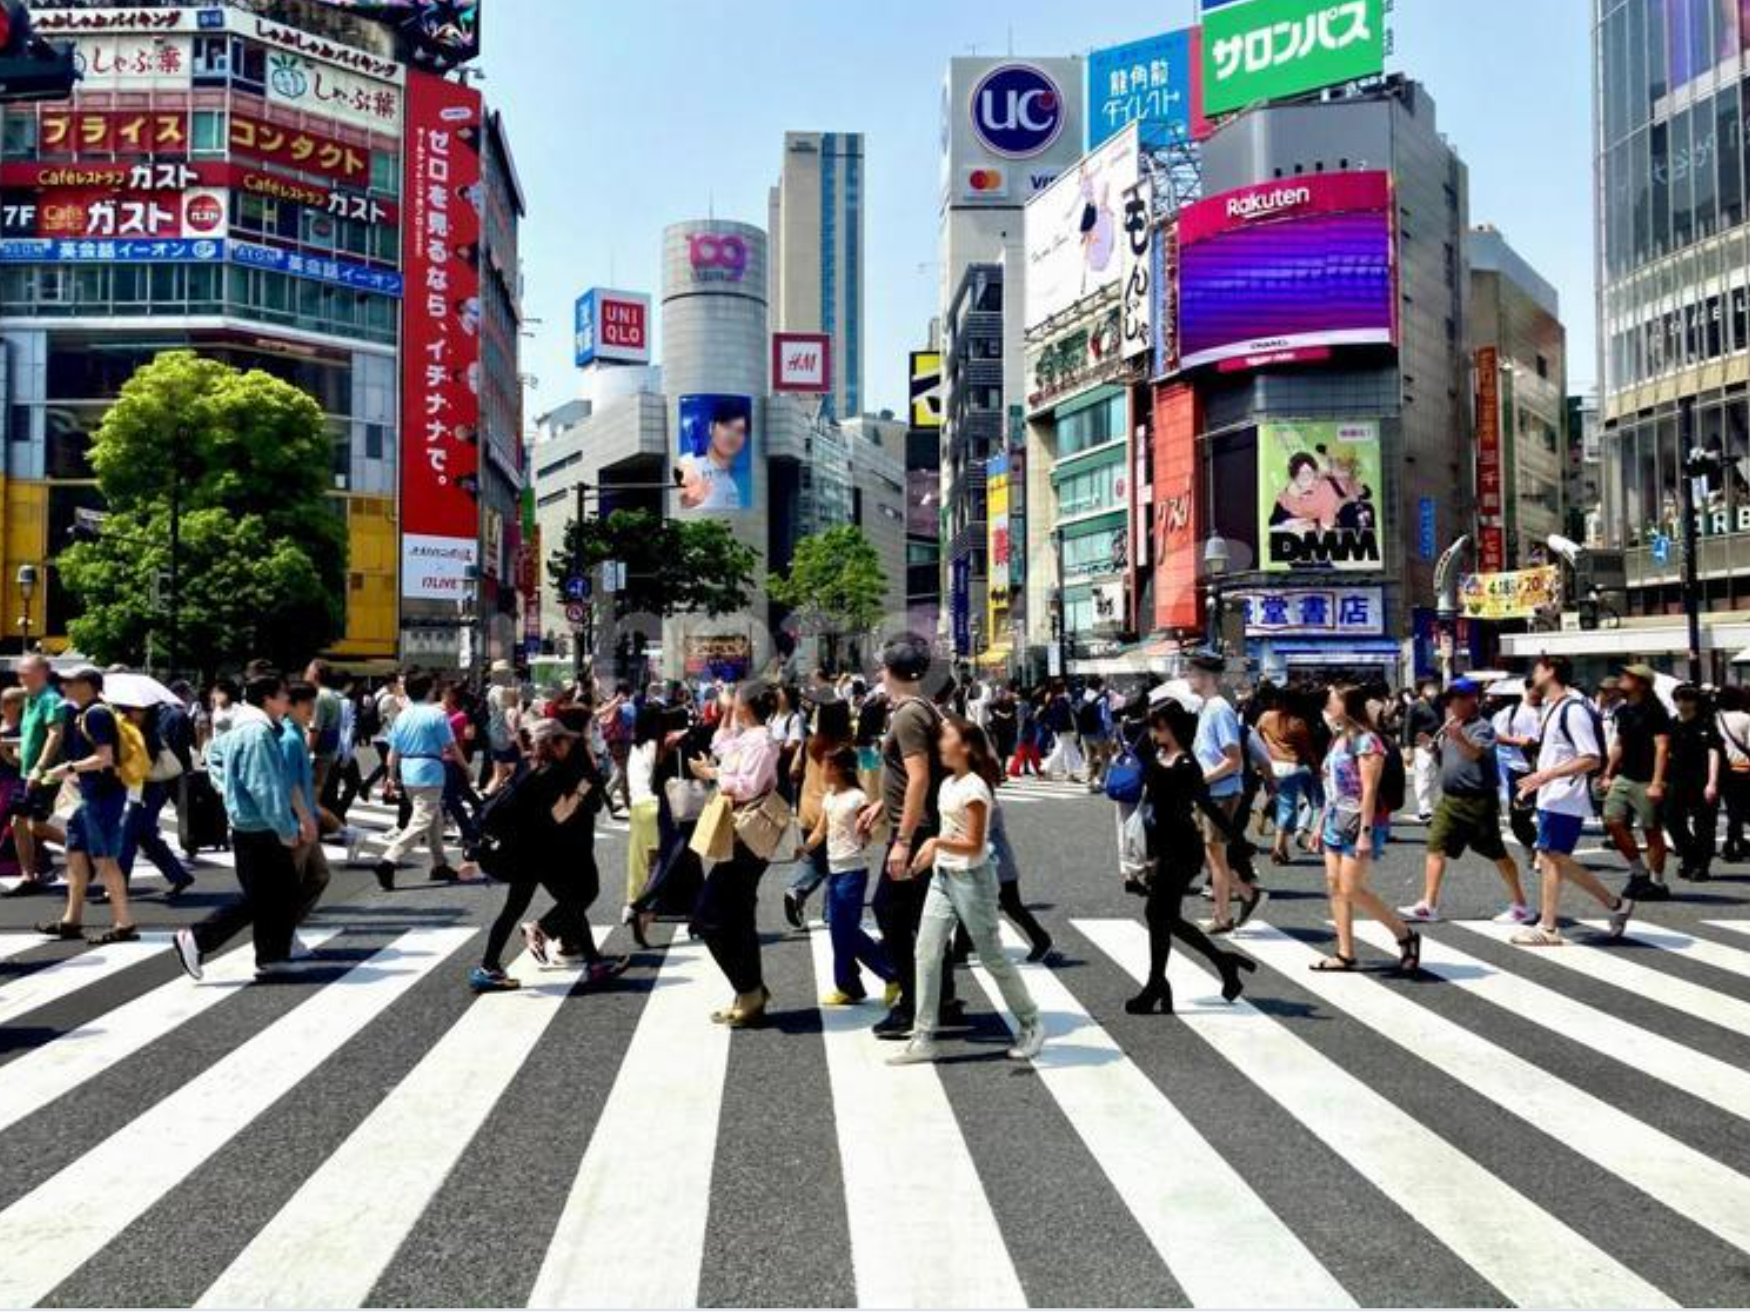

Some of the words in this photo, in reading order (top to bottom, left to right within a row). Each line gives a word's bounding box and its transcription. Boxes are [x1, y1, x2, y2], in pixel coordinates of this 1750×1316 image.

[1212, 1, 1370, 80] サロンパス
[93, 45, 181, 73] しゃぶ葉
[314, 73, 396, 120] しゃぶ葉
[982, 89, 1055, 131] UC
[231, 119, 364, 173] コンタクト
[130, 164, 198, 188] ガスト
[3, 205, 36, 226] 7F
[328, 192, 387, 223] ガスト
[1226, 186, 1310, 217] Rakuten
[87, 201, 173, 235] ガスト
[59, 242, 186, 258] 英会話イーオン
[605, 305, 637, 325] UNI
[605, 324, 640, 343] QLO
[1268, 528, 1380, 562] DMM
